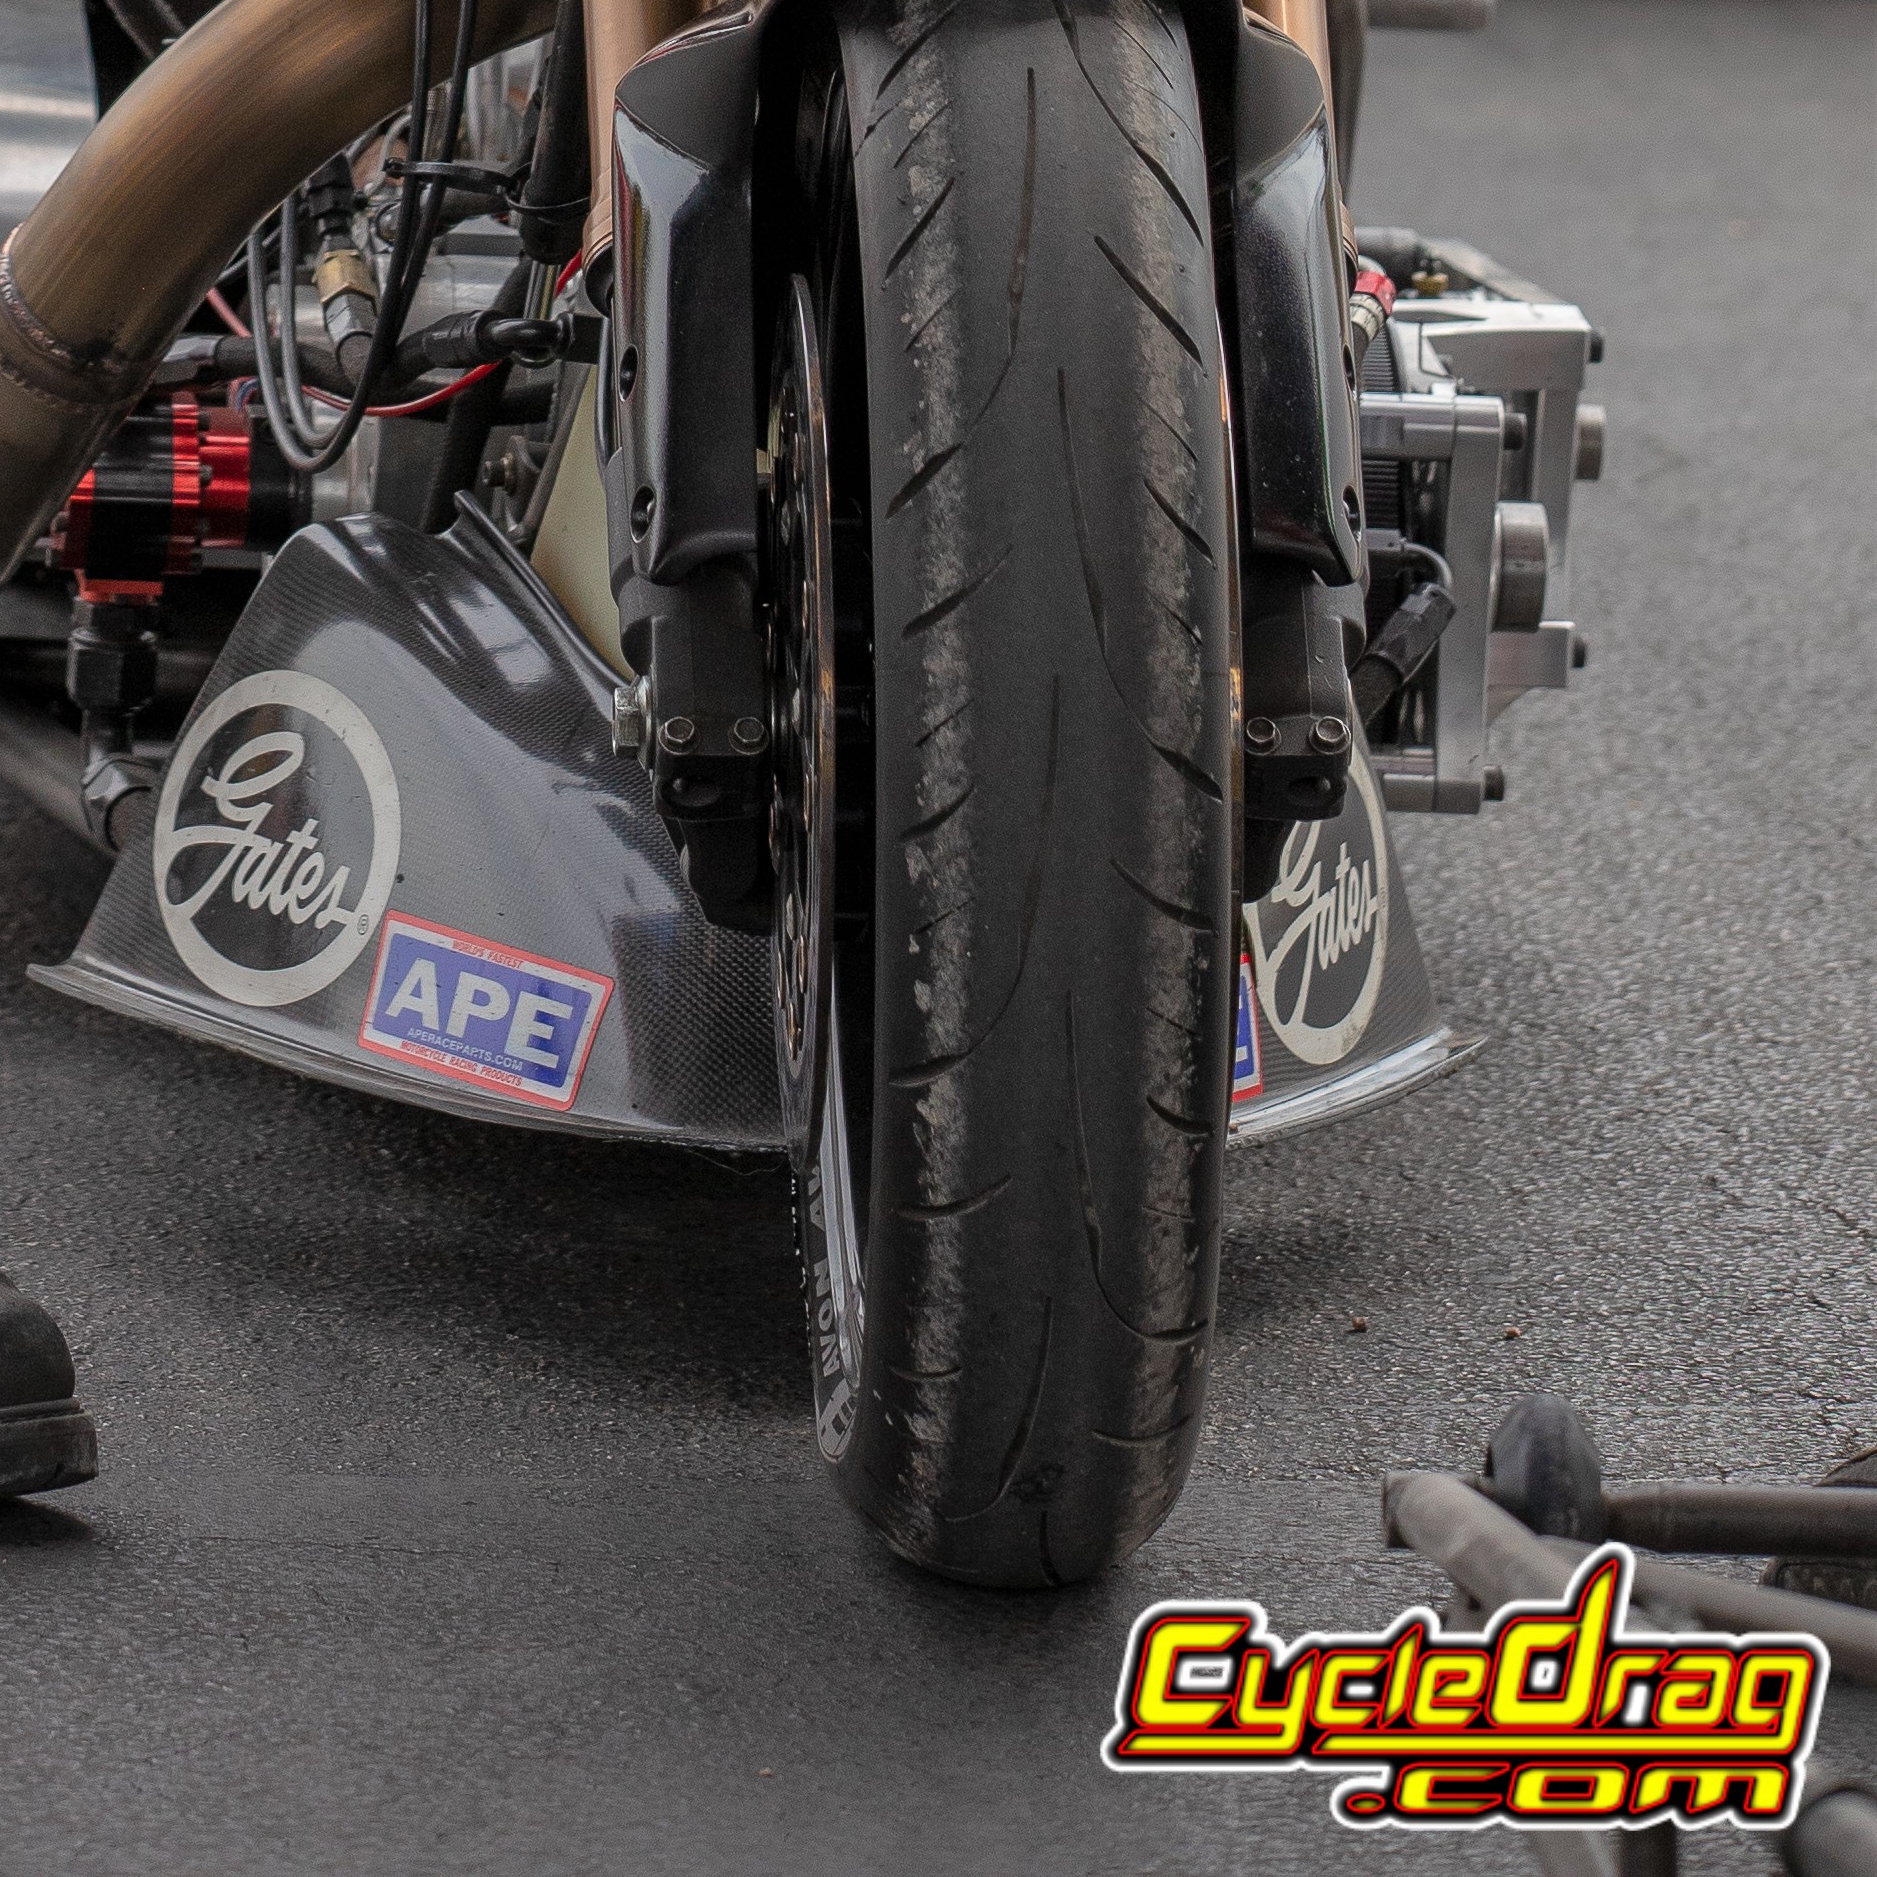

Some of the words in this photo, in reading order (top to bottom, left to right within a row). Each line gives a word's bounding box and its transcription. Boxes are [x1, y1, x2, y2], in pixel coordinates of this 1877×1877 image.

[169, 731, 356, 929] Gates
[486, 949, 524, 970] FASTEST
[385, 957, 573, 1069] APE
[407, 1027, 523, 1071] APERACEPARTS.COM
[449, 1055, 478, 1072] RACING
[479, 1067, 522, 1087] PRODUCTS
[814, 1258, 841, 1377] AVON
